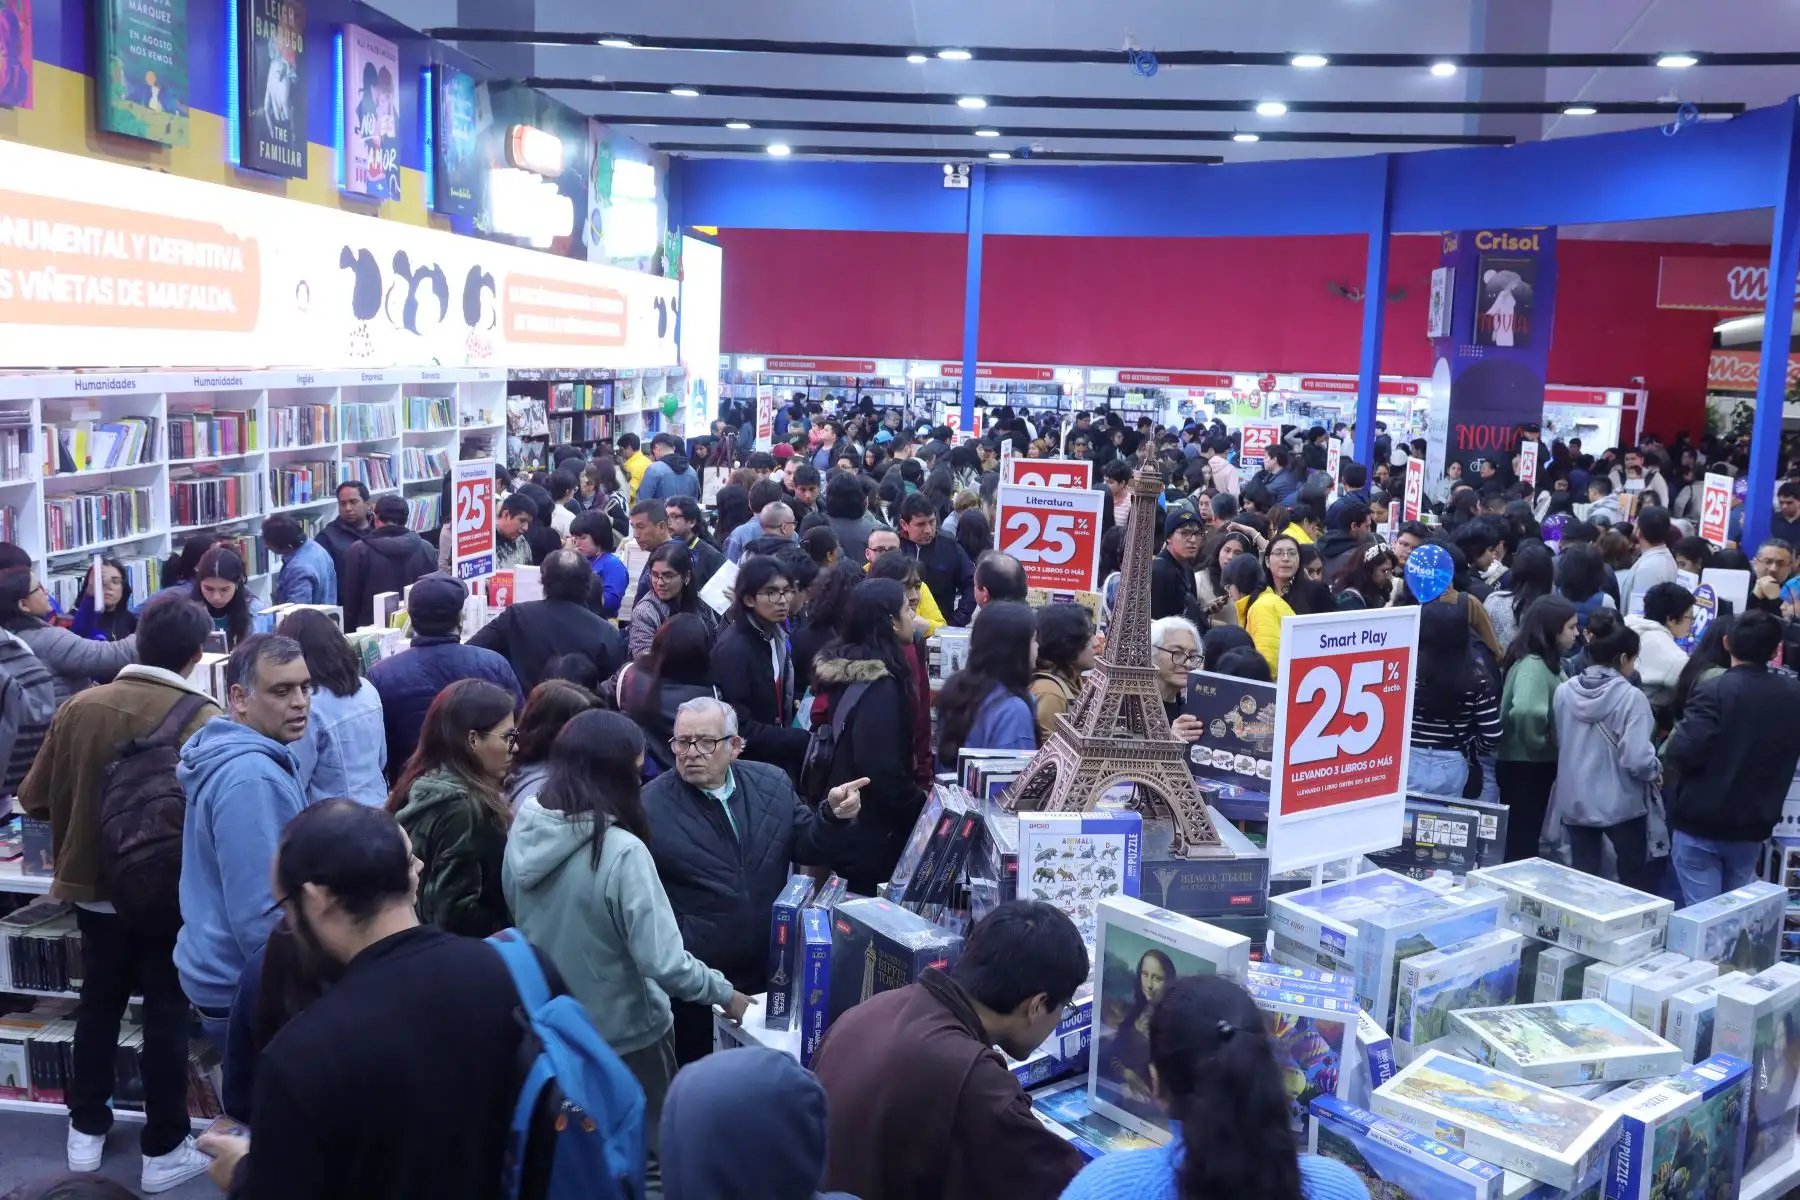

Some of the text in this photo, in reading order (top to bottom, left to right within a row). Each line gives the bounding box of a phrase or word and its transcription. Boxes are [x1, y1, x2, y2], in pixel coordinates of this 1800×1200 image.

[274, 126, 287, 141] THE
[260, 141, 302, 168] FAMILIAR
[367, 147, 398, 172] AMOR
[1475, 231, 1540, 251] Crisol
[74, 378, 137, 391] Humanidades
[193, 375, 243, 387] Humanidades
[296, 374, 314, 385] Inglés
[361, 372, 383, 383] Empresa
[1244, 429, 1272, 448] 25
[458, 483, 486, 534] 25
[1026, 496, 1073, 508] Literatura
[1705, 490, 1725, 525] 25
[1042, 567, 1063, 575] LIBROS
[1070, 568, 1085, 576] MÁS
[1320, 629, 1388, 648] Smart Play
[1383, 684, 1402, 693] dscto.
[1289, 660, 1385, 766] 25
[1291, 754, 1393, 782] LLEVANDO 3 LIBROS O MÁS
[1297, 785, 1321, 796] LLEVANDO
[1324, 782, 1338, 792] LIBRO
[1338, 779, 1354, 789] OBTÉN
[1062, 838, 1093, 846] ANIMALS
[1127, 833, 1138, 864] PUZZLE
[1616, 1144, 1631, 1186] PUZZLE
